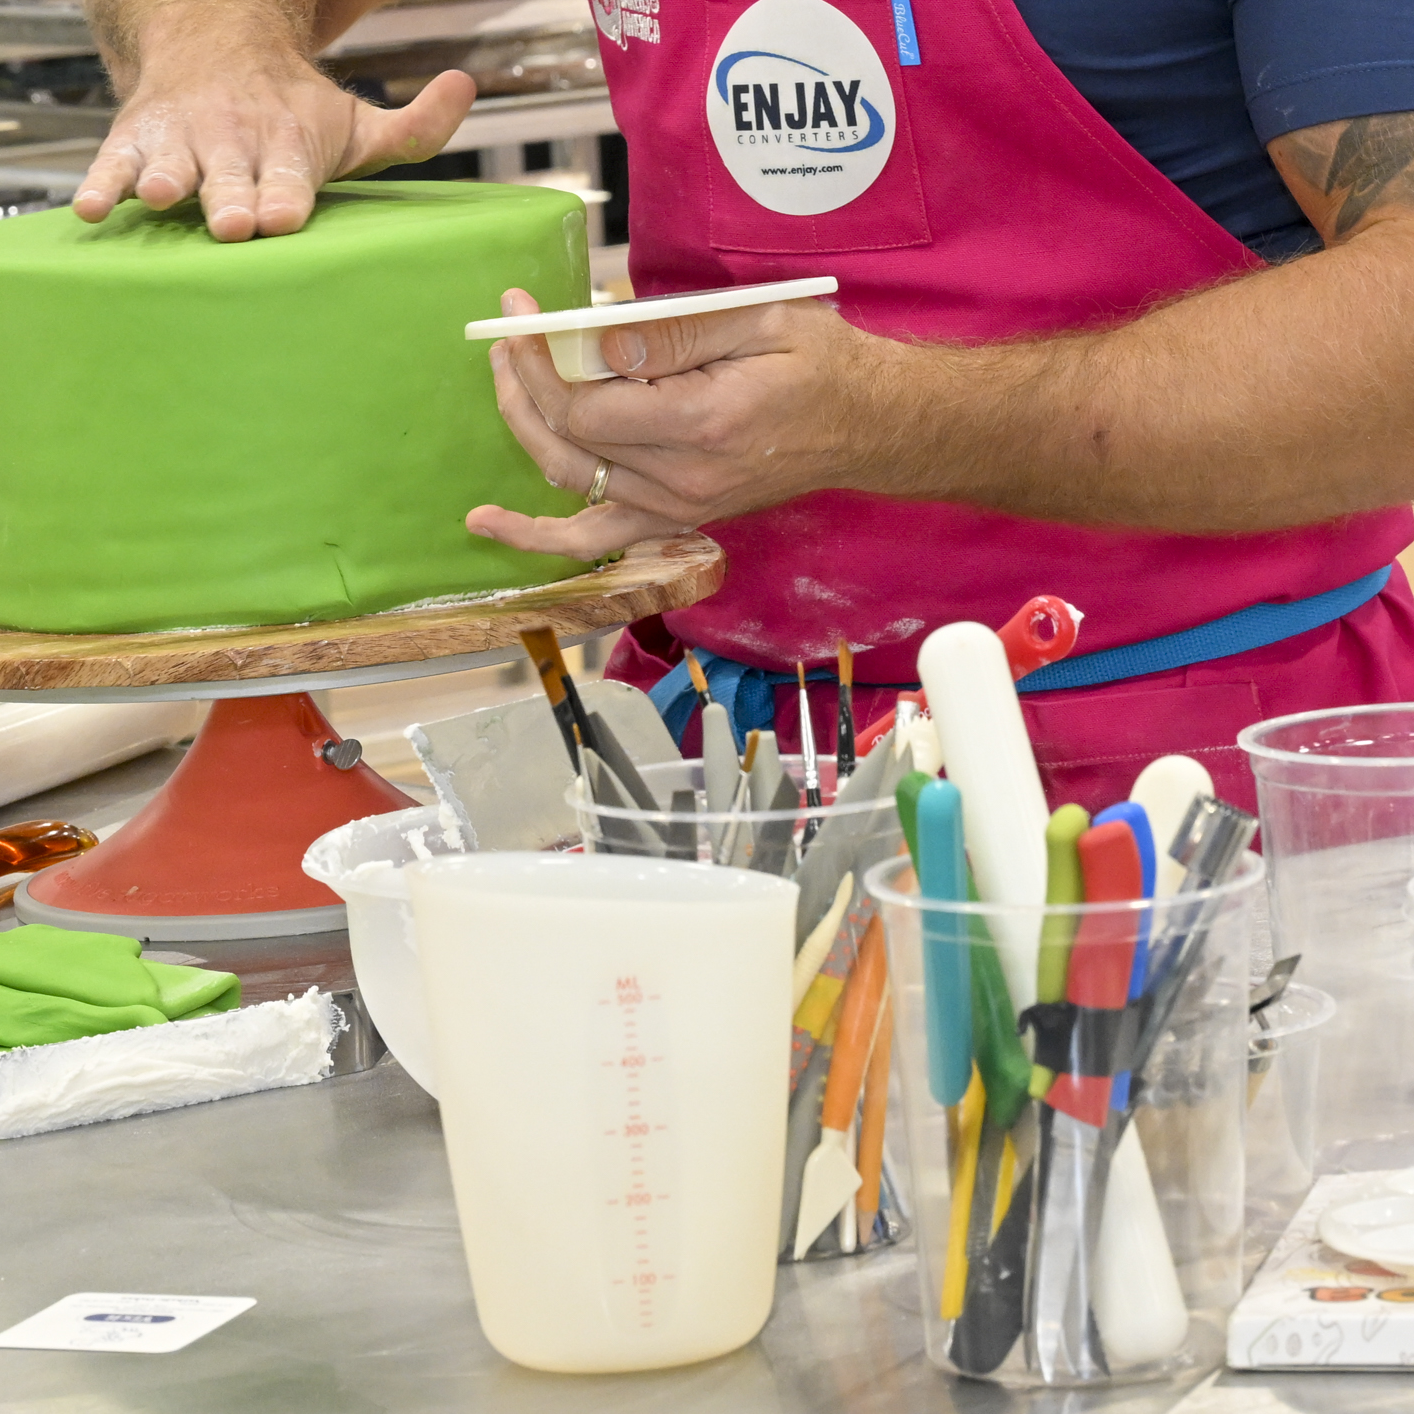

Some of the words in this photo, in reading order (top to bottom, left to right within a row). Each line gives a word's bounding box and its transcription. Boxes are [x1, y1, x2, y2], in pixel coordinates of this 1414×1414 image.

[732, 80, 861, 131] ENJAY
[737, 130, 859, 145] CONVERTERS
[761, 163, 844, 177] www.enjay.com
[620, 1054, 647, 1068] 400
[625, 1192, 652, 1207] 200
[632, 1273, 657, 1286] 100
